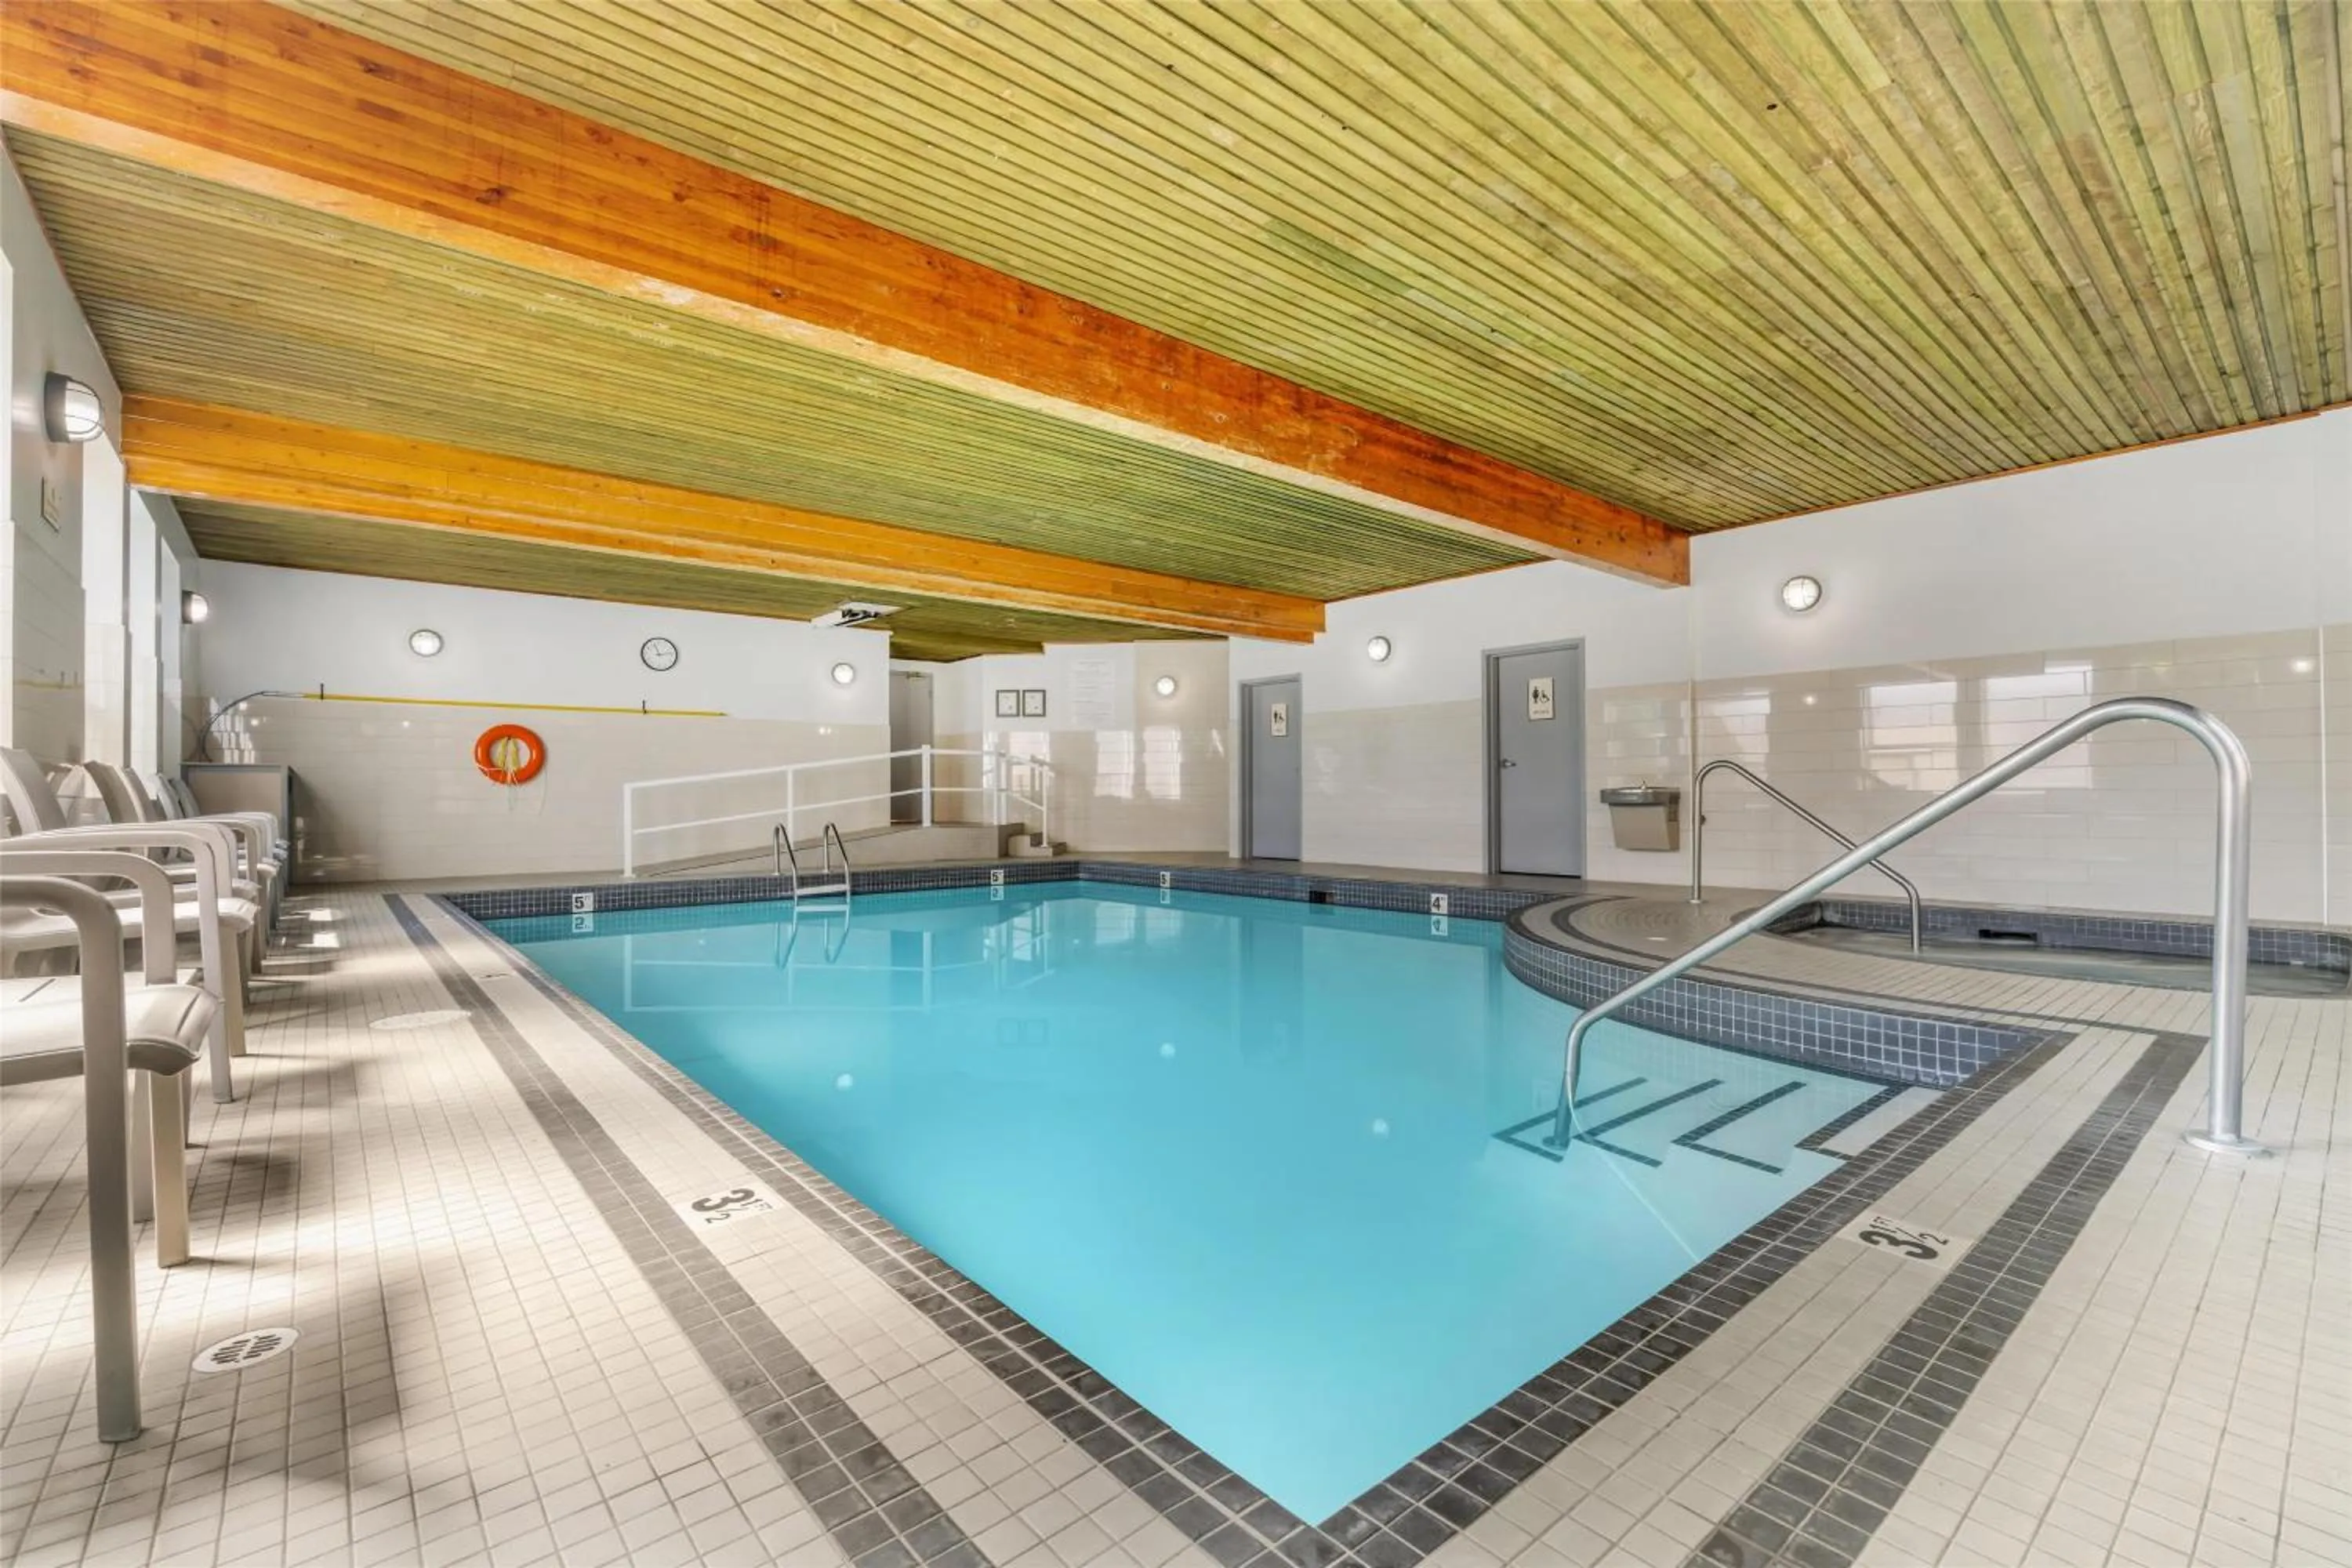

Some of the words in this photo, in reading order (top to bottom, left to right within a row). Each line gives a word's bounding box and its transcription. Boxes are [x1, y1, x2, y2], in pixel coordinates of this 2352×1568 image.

[575, 896, 585, 909] 5
[1432, 896, 1441, 912] 4
[691, 1188, 755, 1212] 3
[1859, 1230, 1938, 1260] 3
